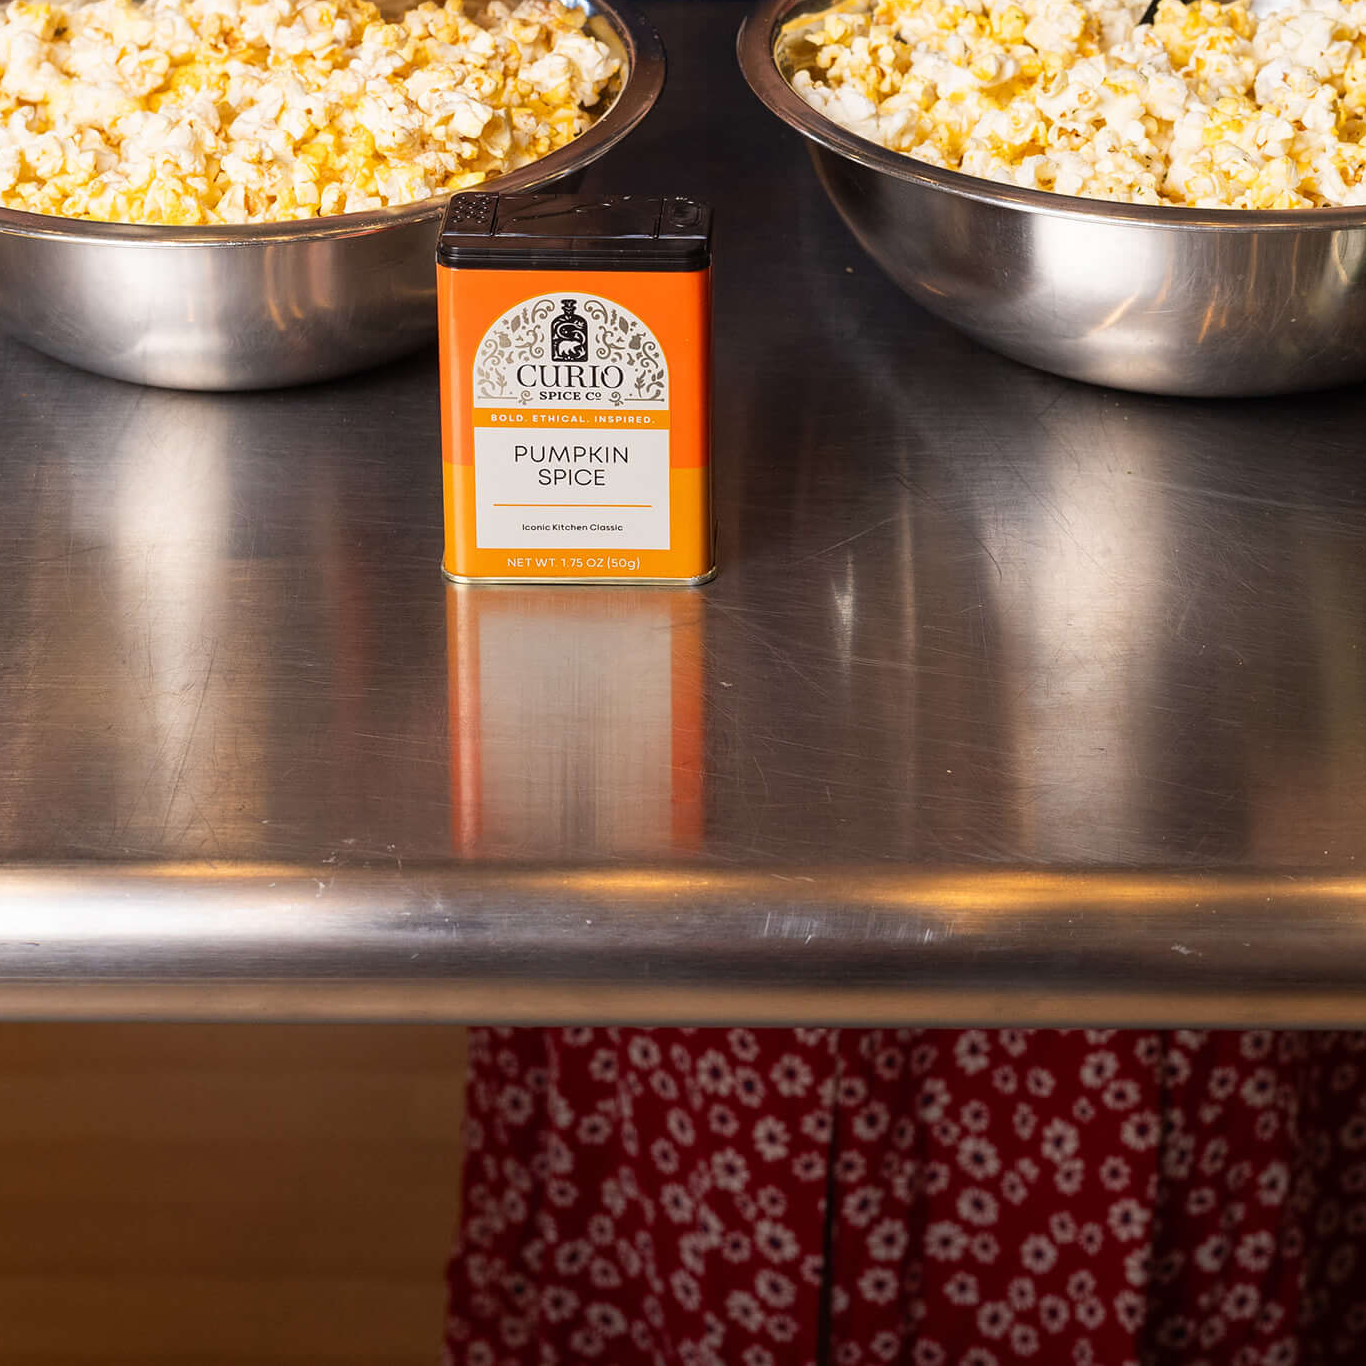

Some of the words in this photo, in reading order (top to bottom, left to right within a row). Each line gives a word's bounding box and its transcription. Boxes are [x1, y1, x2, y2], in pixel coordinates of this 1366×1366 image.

[516, 363, 624, 390] CURIO
[539, 391, 583, 401] SPICE
[490, 413, 529, 423] BOLD.
[532, 414, 591, 424] ETHICAL.
[594, 415, 656, 425] INSPIRED.
[514, 445, 629, 464] PUMPKIN
[538, 468, 606, 486] SPICE
[521, 523, 551, 532] Iconic
[552, 523, 588, 532] Kitchen
[589, 523, 623, 532] Classic
[507, 557, 533, 569] NET
[561, 558, 584, 569] 1.75
[586, 558, 605, 570] OZ
[606, 557, 641, 571] (50g)
